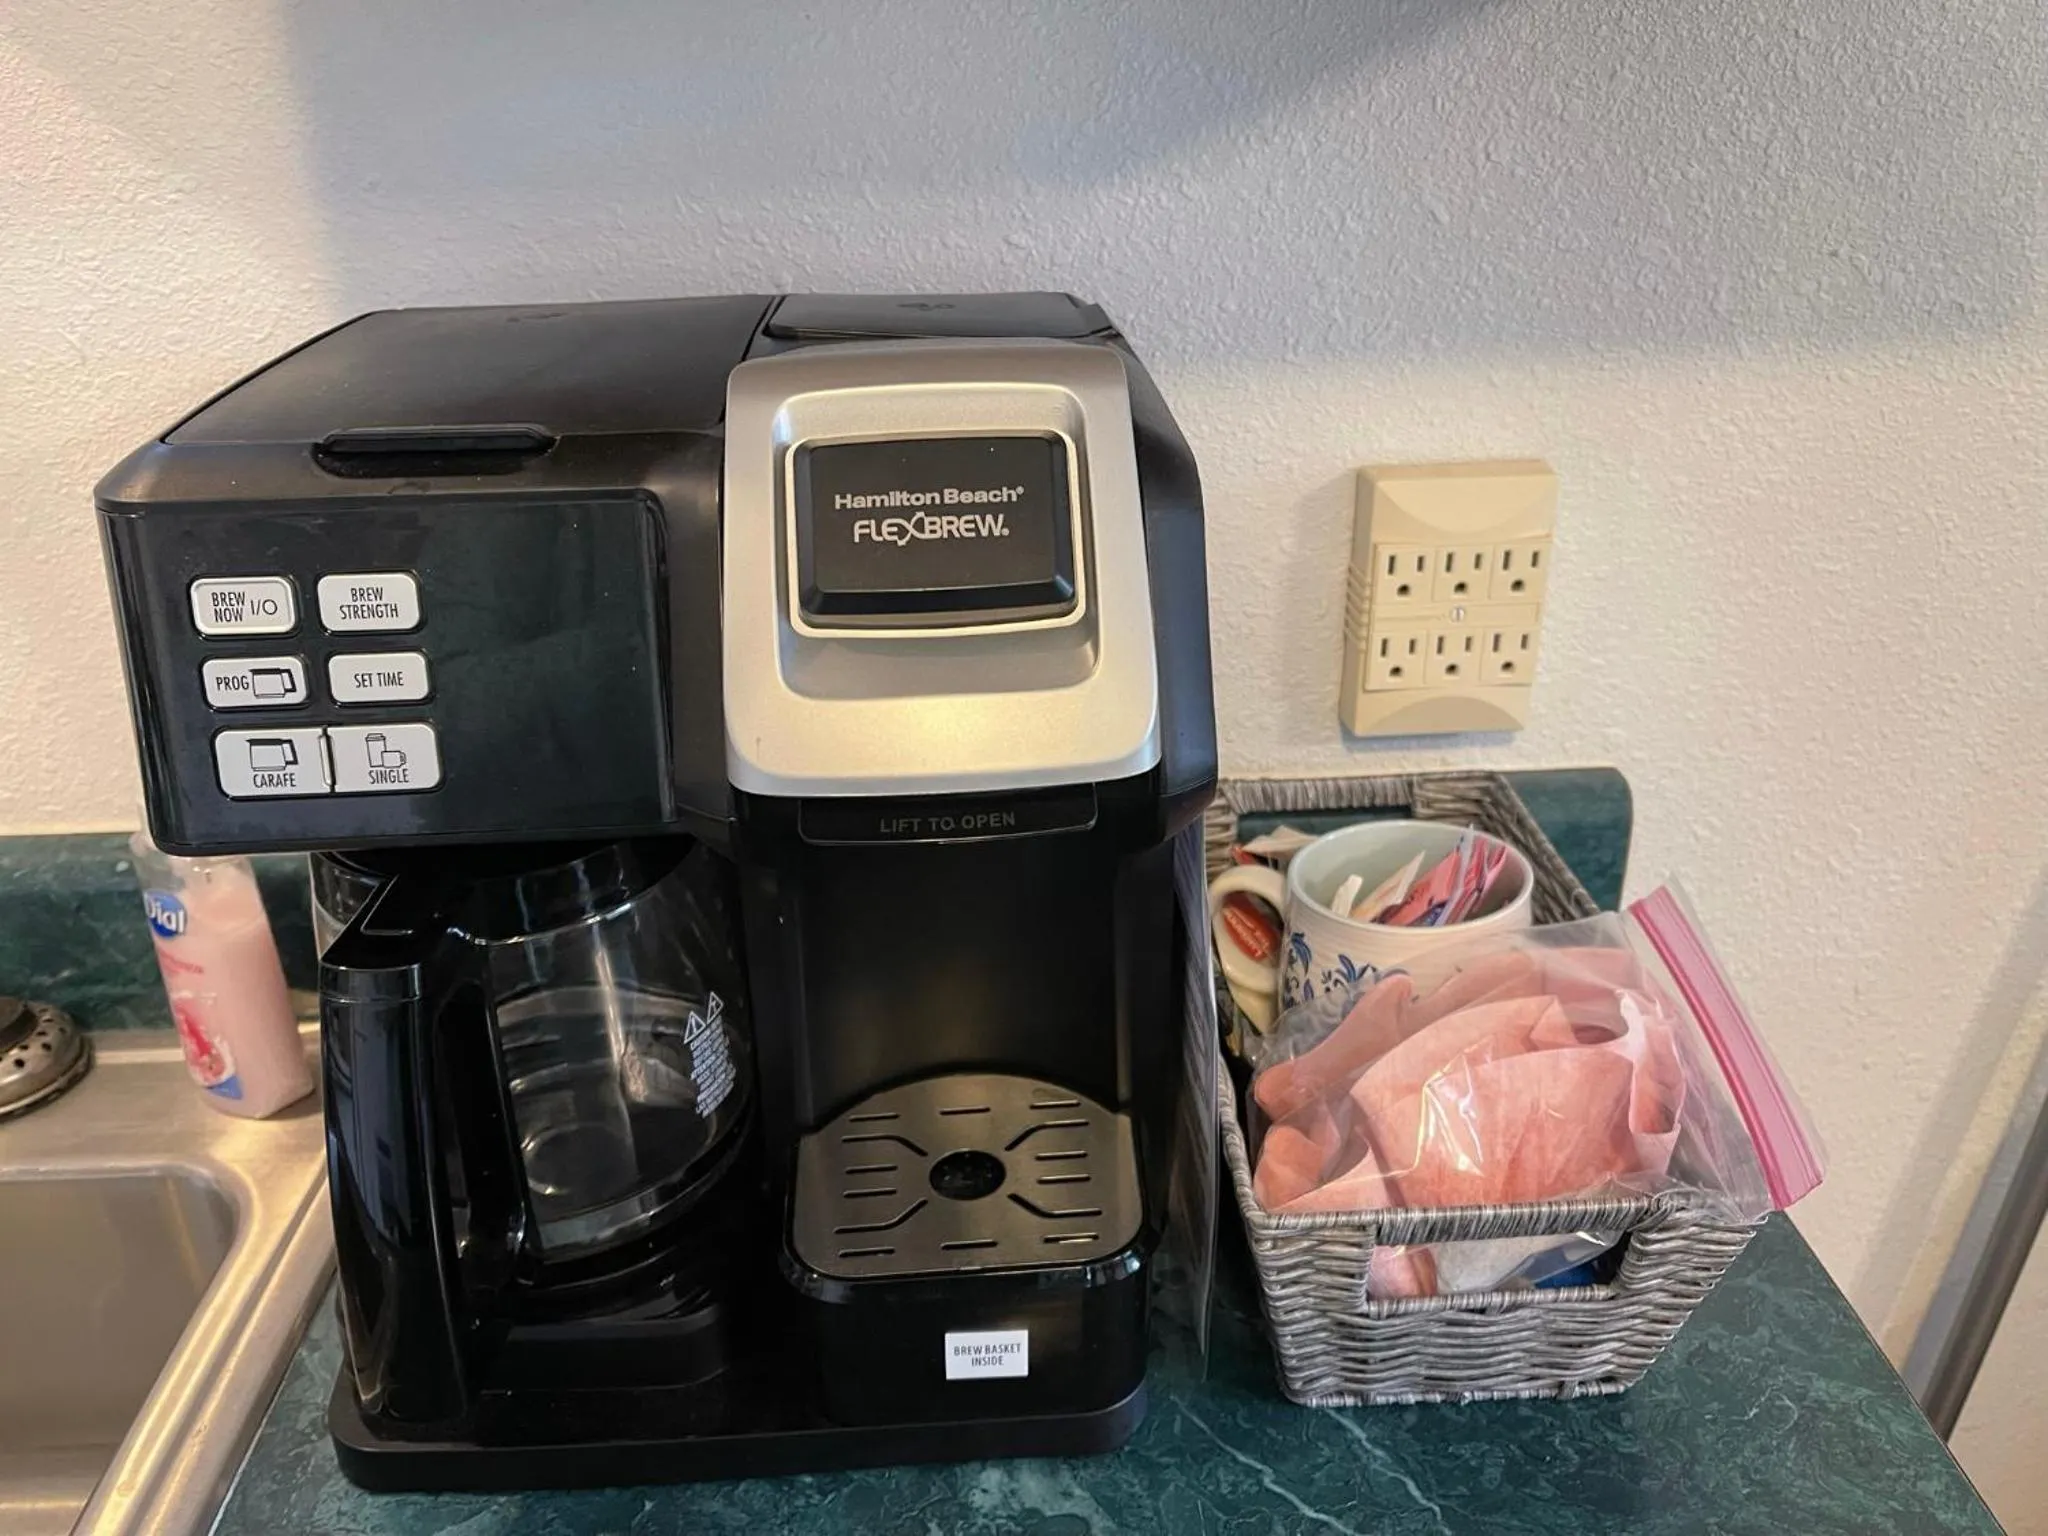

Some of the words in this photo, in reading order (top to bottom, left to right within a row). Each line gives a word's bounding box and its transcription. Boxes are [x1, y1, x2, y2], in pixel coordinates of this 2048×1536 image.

[834, 490, 940, 510] Hamilton
[211, 592, 245, 607] BREW
[350, 587, 384, 602] BREW
[213, 608, 244, 623] NOW
[339, 603, 399, 620] STRENGTH
[216, 676, 249, 691] PROG
[354, 673, 376, 688] SET
[377, 671, 404, 687] TIME
[253, 773, 296, 788] CARAFE
[368, 769, 409, 784] SINGLE
[879, 818, 922, 833] LIFT
[928, 816, 956, 831] TO
[960, 811, 1016, 829] OPEN
[953, 1346, 983, 1356] BREW
[984, 1343, 1021, 1355] BASKET
[971, 1356, 1004, 1367] INSIDE
